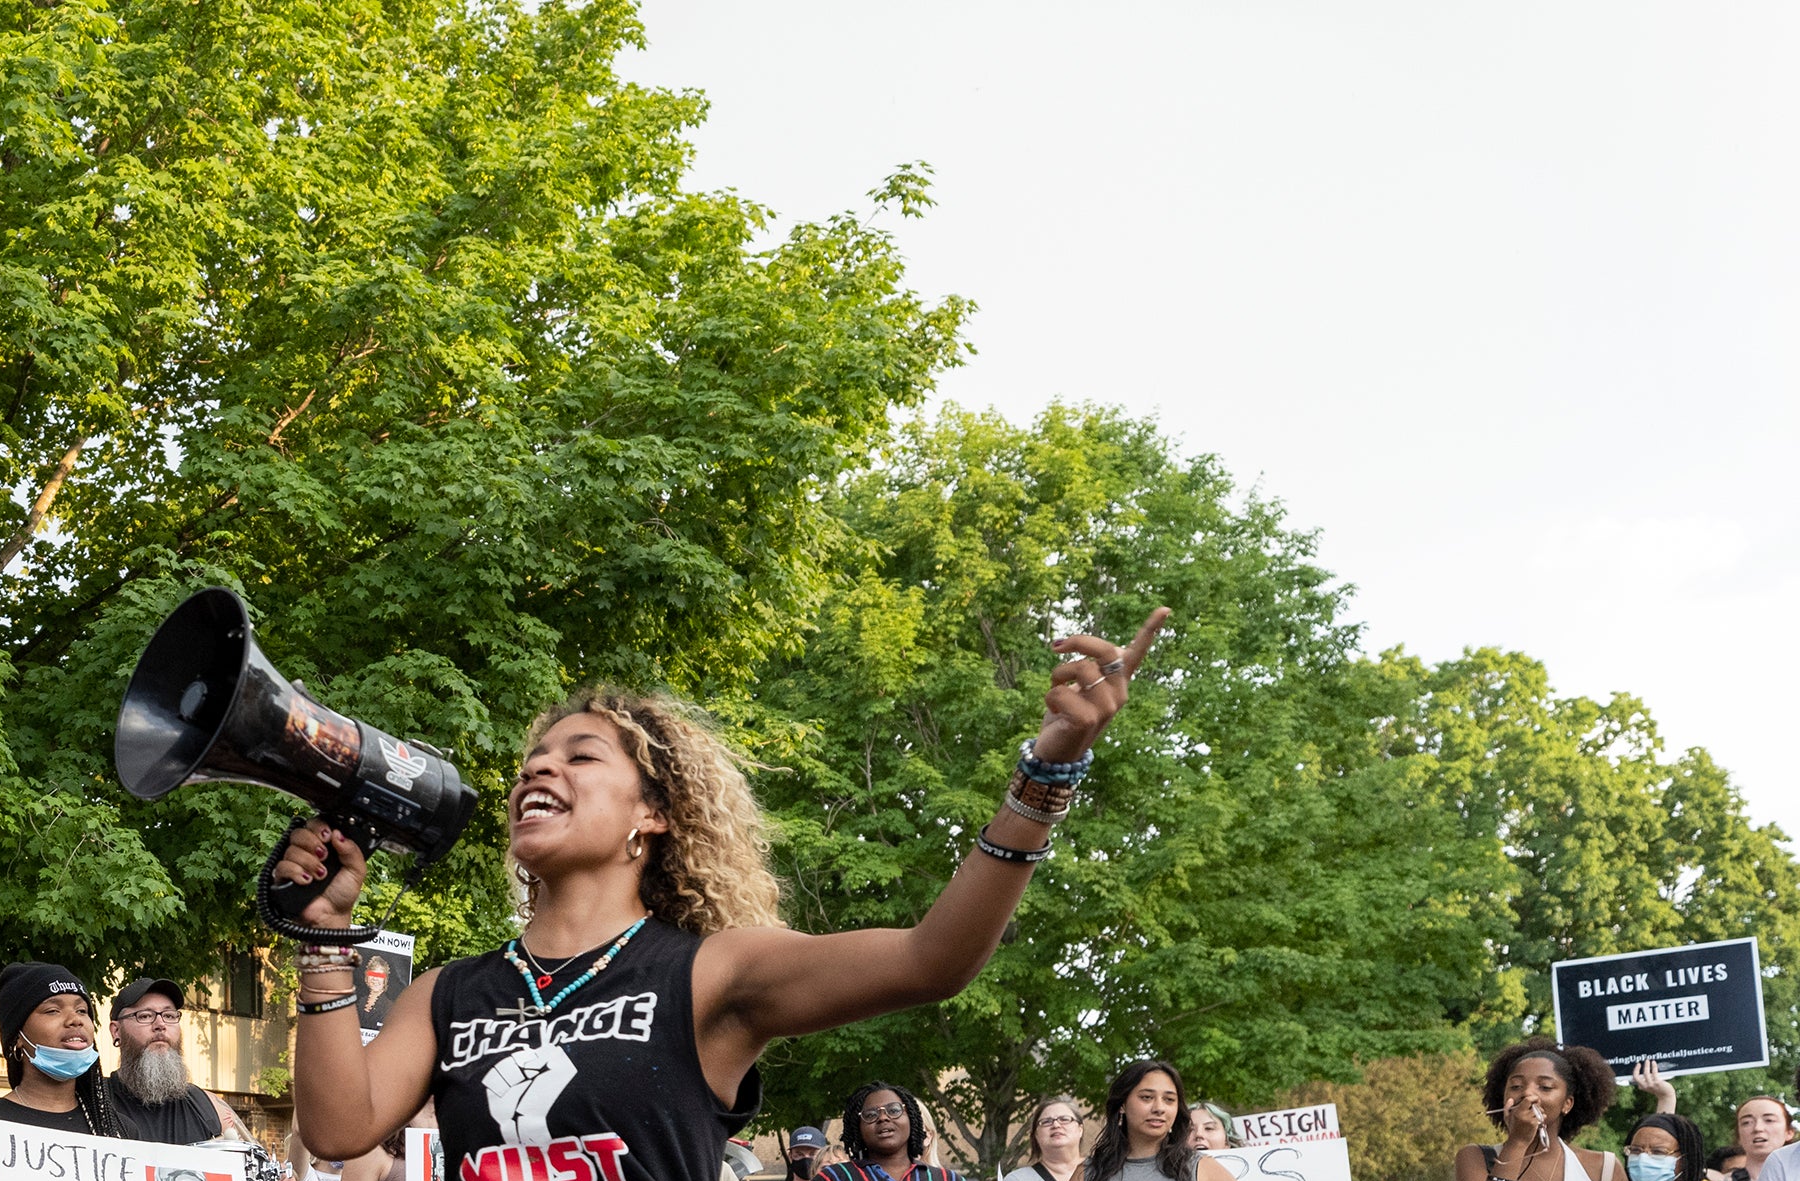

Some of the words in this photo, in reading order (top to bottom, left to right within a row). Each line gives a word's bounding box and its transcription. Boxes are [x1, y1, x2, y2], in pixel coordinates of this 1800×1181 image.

[387, 938, 411, 950] NOW!
[48, 980, 78, 994] Thug
[1578, 972, 1650, 999] BLACK
[1665, 963, 1728, 988] LIVES
[1617, 1000, 1701, 1025] MATTER
[441, 991, 658, 1072] CHANGE
[1242, 1108, 1327, 1141] RESIGN
